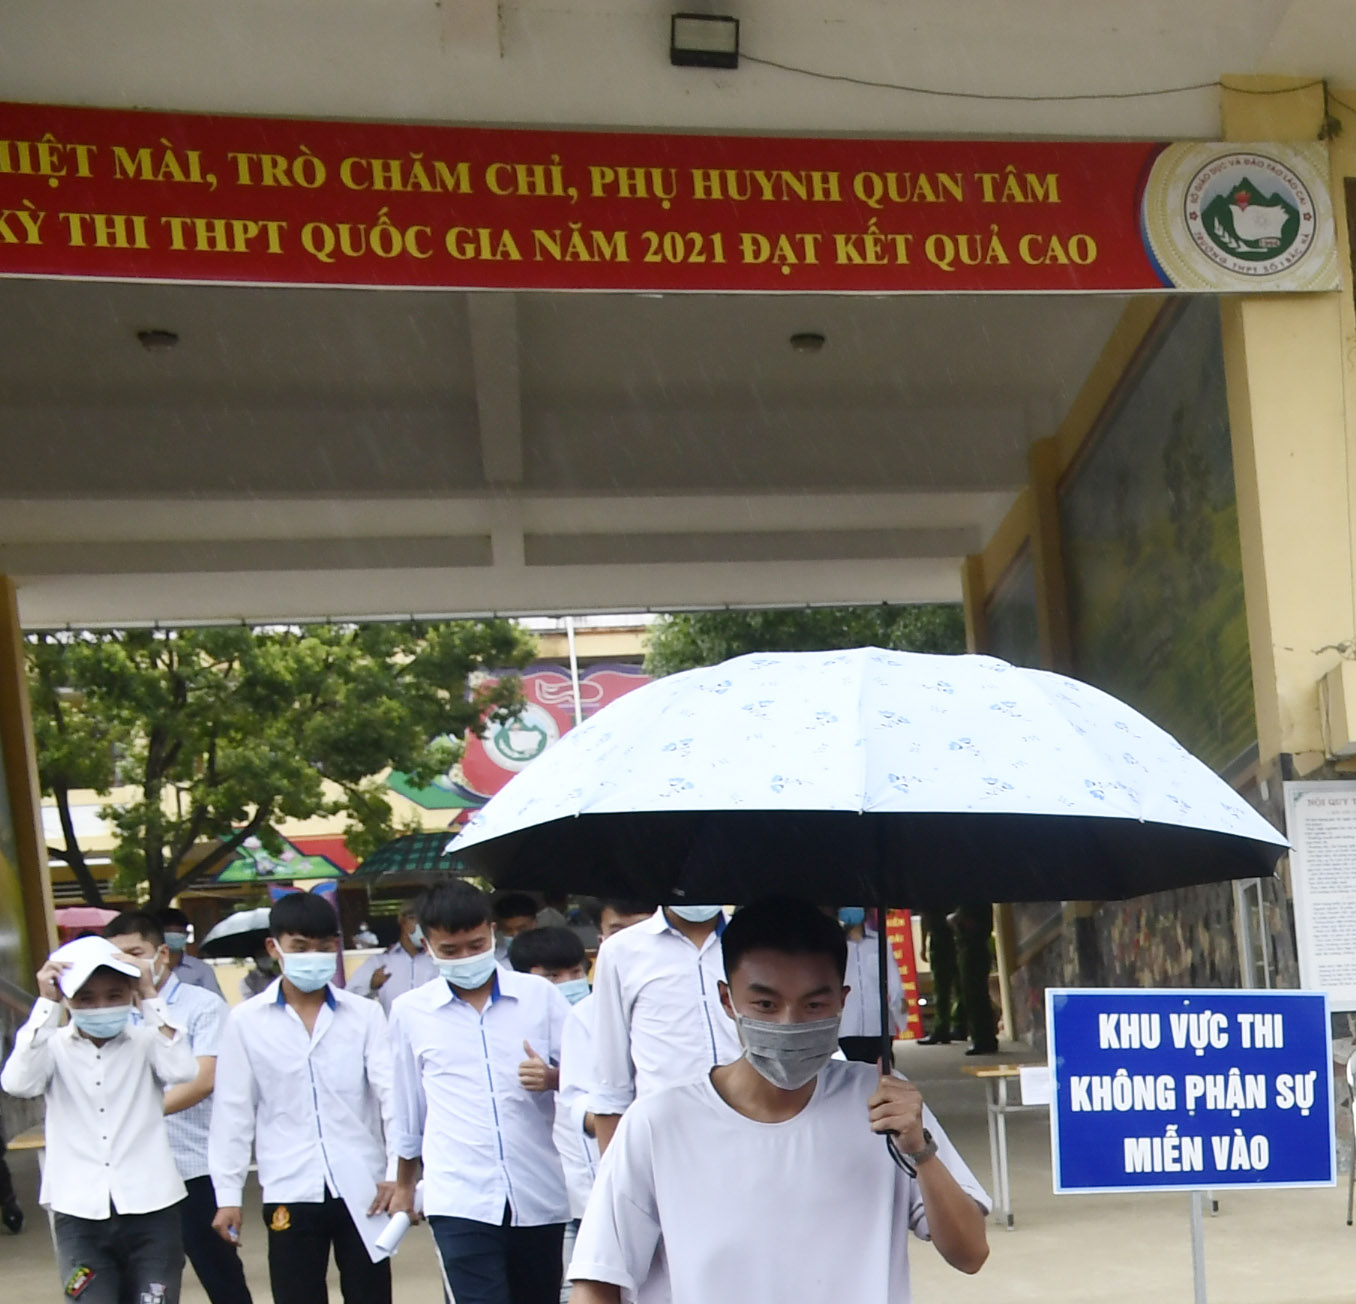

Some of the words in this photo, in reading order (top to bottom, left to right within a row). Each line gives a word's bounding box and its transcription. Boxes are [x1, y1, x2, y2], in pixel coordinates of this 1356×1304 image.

[112, 137, 218, 188] MÀI,
[228, 145, 327, 189] TRÒ
[339, 153, 473, 194] CHĂM
[485, 154, 578, 201] CHỈ,
[589, 166, 678, 209] PHỤ
[692, 168, 842, 201] HUYNH
[852, 171, 963, 209] QUAN
[975, 164, 1060, 203] TÂM
[59, 212, 150, 249] THI
[161, 217, 287, 254] THPT
[301, 206, 434, 263] QUỐC
[445, 226, 523, 261] GIA
[532, 222, 629, 262] NĂM
[642, 230, 726, 264] 2021
[740, 232, 822, 275] ĐẠT
[834, 217, 914, 265] KẾT
[924, 223, 1009, 272] QUẢ
[1018, 233, 1098, 265] CAO
[1099, 1013, 1161, 1049] KHU
[1169, 1010, 1228, 1056] VỰC
[1237, 1014, 1284, 1049] THI
[1070, 1068, 1176, 1112] KHÔNG
[1275, 1071, 1317, 1116] SỰ
[1124, 1124, 1204, 1173] MIỄN
[1211, 1129, 1270, 1171] VÀO
